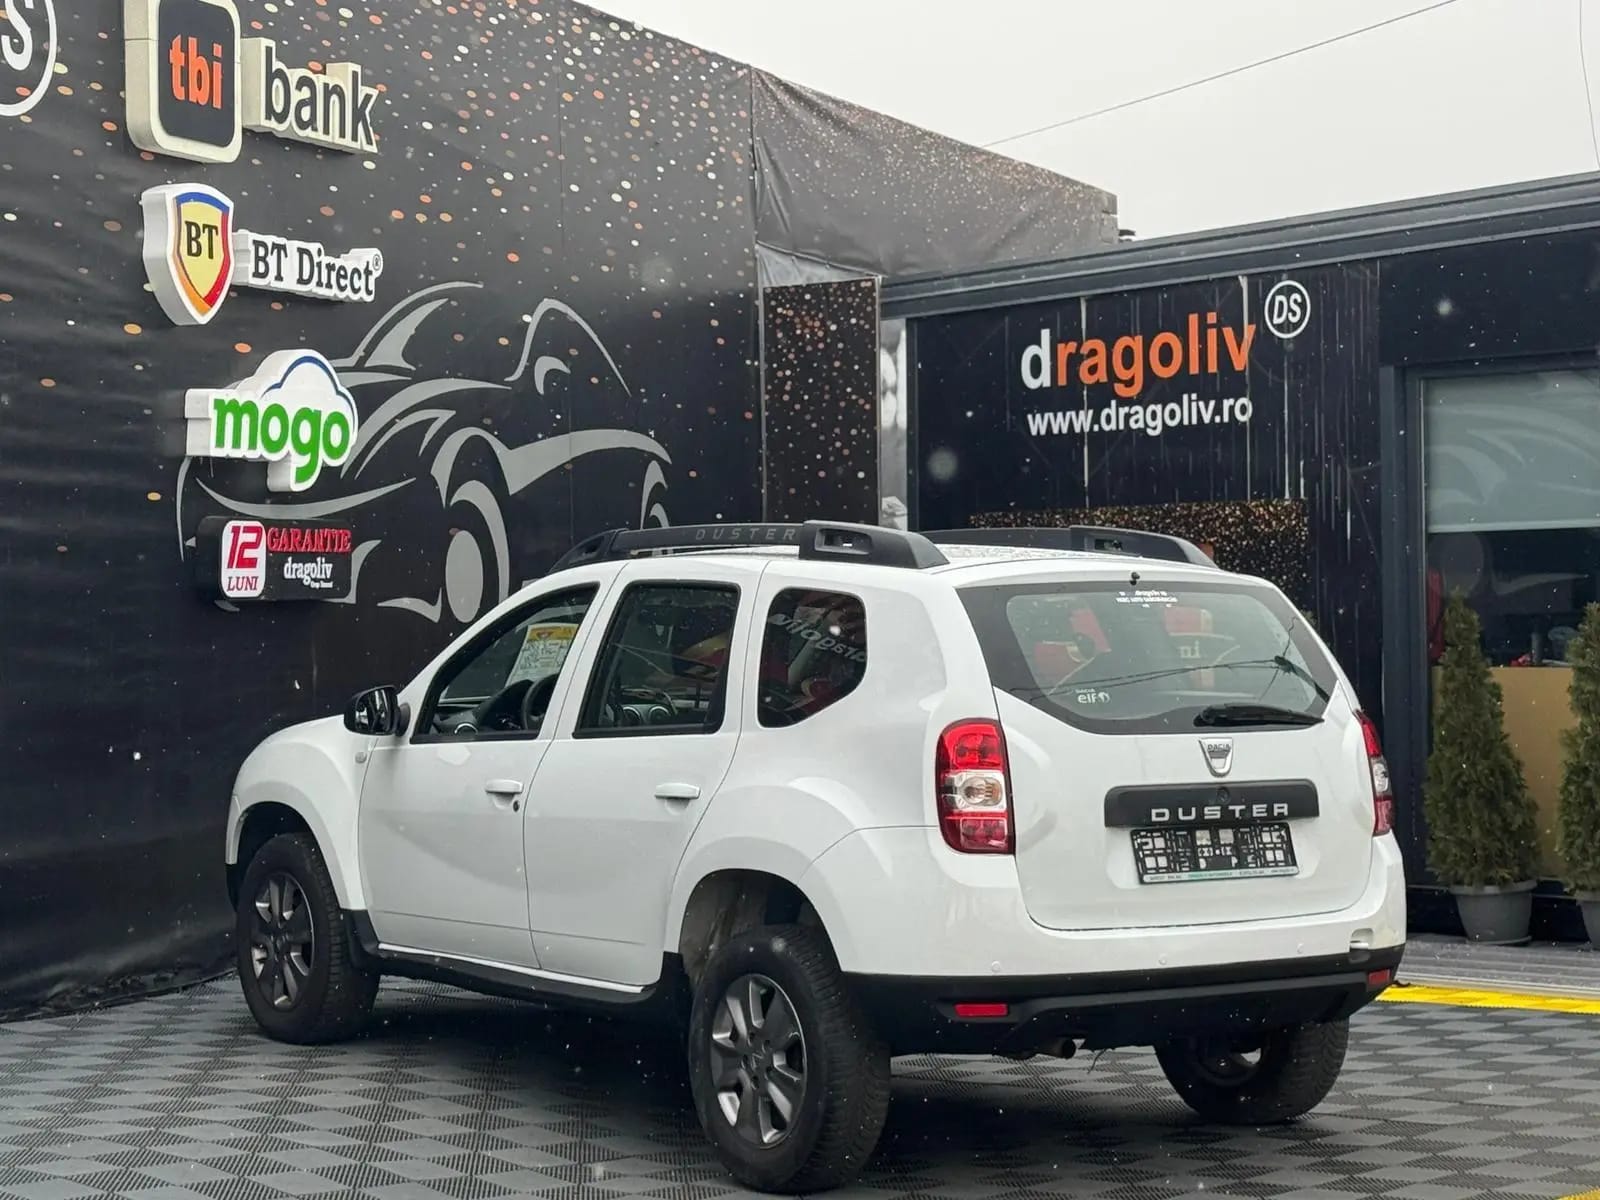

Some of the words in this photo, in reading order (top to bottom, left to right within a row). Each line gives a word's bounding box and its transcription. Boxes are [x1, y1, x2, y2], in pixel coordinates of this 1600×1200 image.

[169, 34, 223, 109] tbi
[264, 45, 378, 147] bank
[184, 221, 219, 260] BT
[252, 238, 289, 282] BT
[1272, 292, 1303, 325] DS
[1020, 311, 1257, 398] dragoliv
[1027, 392, 1254, 437] www.dragoliv.ro
[213, 398, 351, 485] mogo
[227, 525, 263, 569] 12
[267, 526, 352, 553] GARANTIE
[695, 527, 796, 541] DUSTER
[226, 576, 260, 592] LUNI
[283, 556, 334, 586] dragoliv
[1151, 802, 1290, 822] DUSTER
